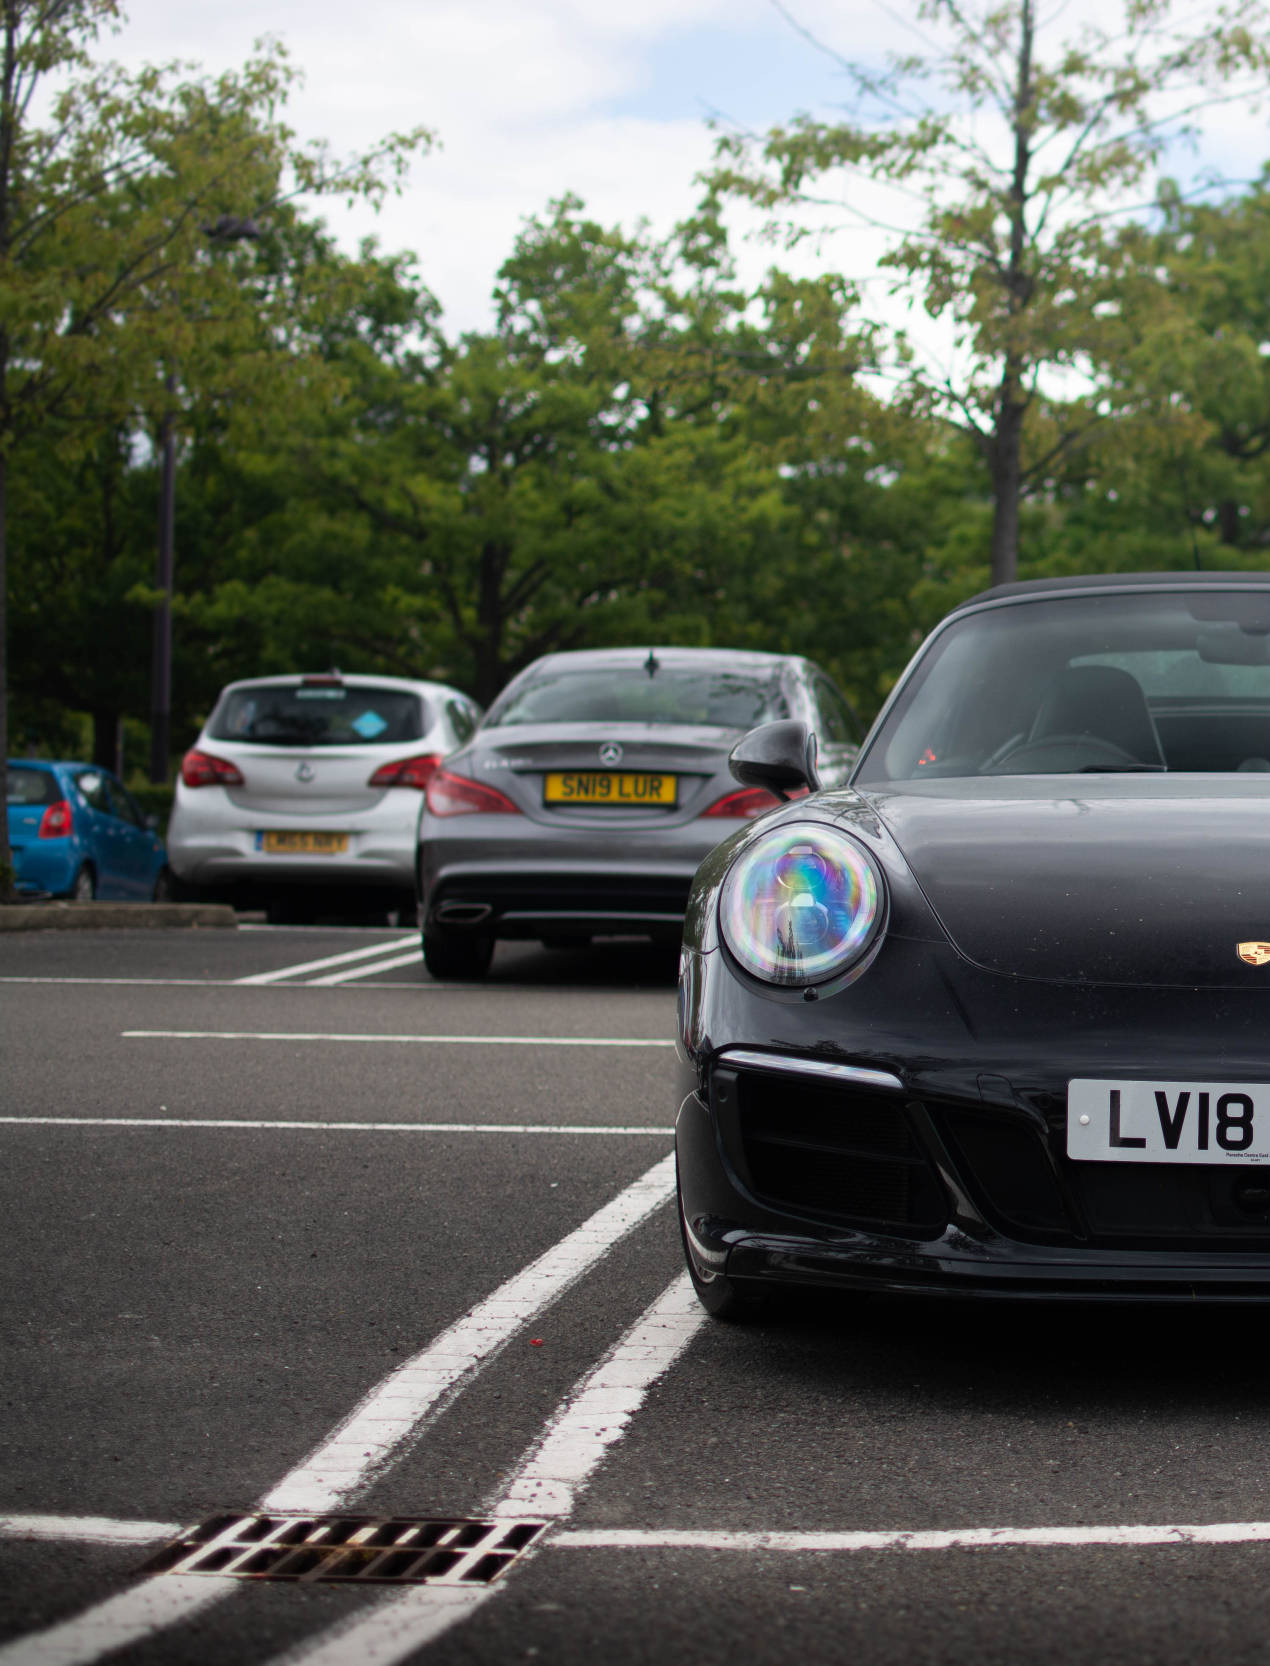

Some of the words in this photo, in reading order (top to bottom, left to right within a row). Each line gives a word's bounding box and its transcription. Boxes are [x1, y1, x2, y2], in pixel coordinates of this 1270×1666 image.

[562, 776, 611, 797] SN19
[618, 776, 662, 798] LUR
[1109, 1090, 1253, 1151] LV18
